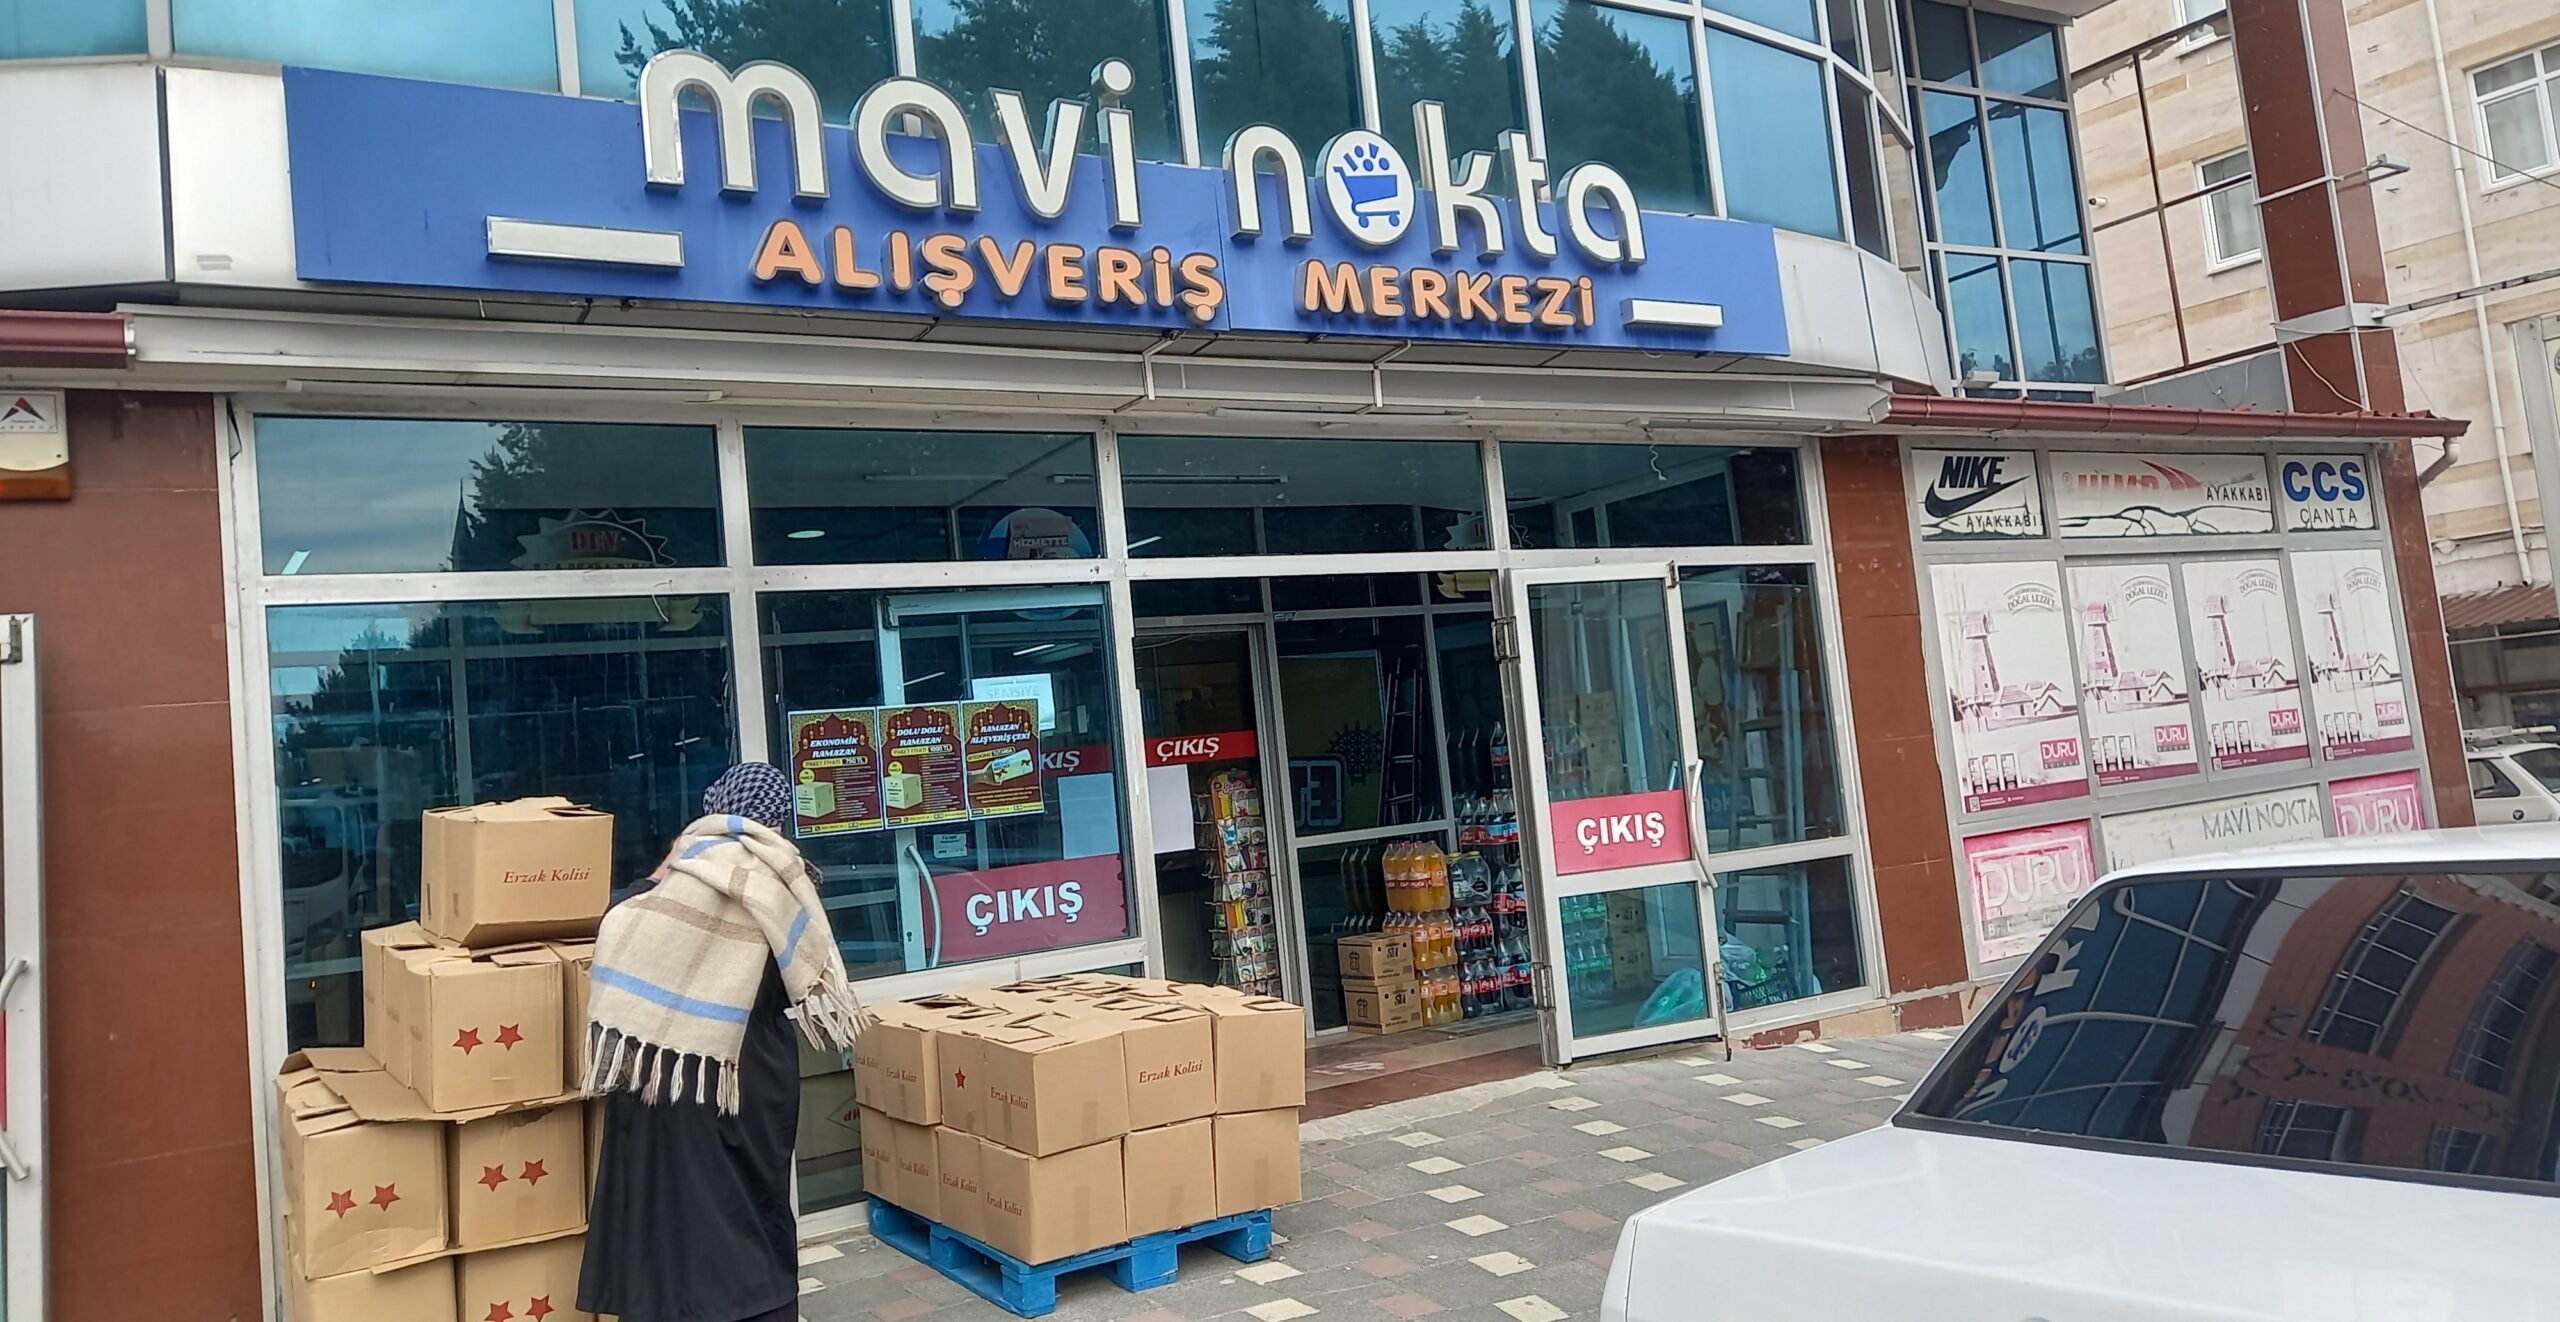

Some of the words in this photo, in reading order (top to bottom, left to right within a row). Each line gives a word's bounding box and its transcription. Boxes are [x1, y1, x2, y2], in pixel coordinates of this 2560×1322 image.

[640, 48, 1143, 232] mavi
[1222, 99, 1647, 268] nokta
[750, 219, 1226, 323] ALIŞVERİŞ
[1299, 257, 1595, 328] MERKEZİ
[1938, 455, 2004, 489] NIKE
[2282, 461, 2366, 502] CCS
[2206, 485, 2269, 503] AYAKKABI
[1965, 513, 2038, 530] AYAKKABI
[2299, 507, 2359, 530] ÇANTA
[2270, 710, 2299, 729] DURU
[2376, 702, 2403, 720] DURU
[896, 727, 920, 737] DOLU
[920, 725, 945, 735] DOLU
[980, 723, 1020, 733] RAMAZAN
[2155, 726, 2188, 743] DURU
[811, 747, 857, 758] RAMAZAN
[899, 736, 942, 747] RAMAZAN
[1156, 736, 1220, 763] ÇIKIŞ
[2041, 740, 2077, 760] DURU
[1041, 750, 1081, 773] KIŞ
[2201, 806, 2254, 841] MAVİ
[2257, 797, 2321, 830] NOKTA
[2339, 797, 2413, 837] DURU
[1576, 810, 1666, 854] ÇIKIŞ
[503, 869, 547, 884] Erzak
[550, 867, 591, 882] Kolisi
[1981, 852, 2082, 911] DURU
[966, 880, 1084, 936] ÇIKIŞ
[1138, 1066, 1170, 1084] Erzak
[1173, 1059, 1203, 1077] Kolisi
[1010, 1093, 1029, 1110] Kolisi
